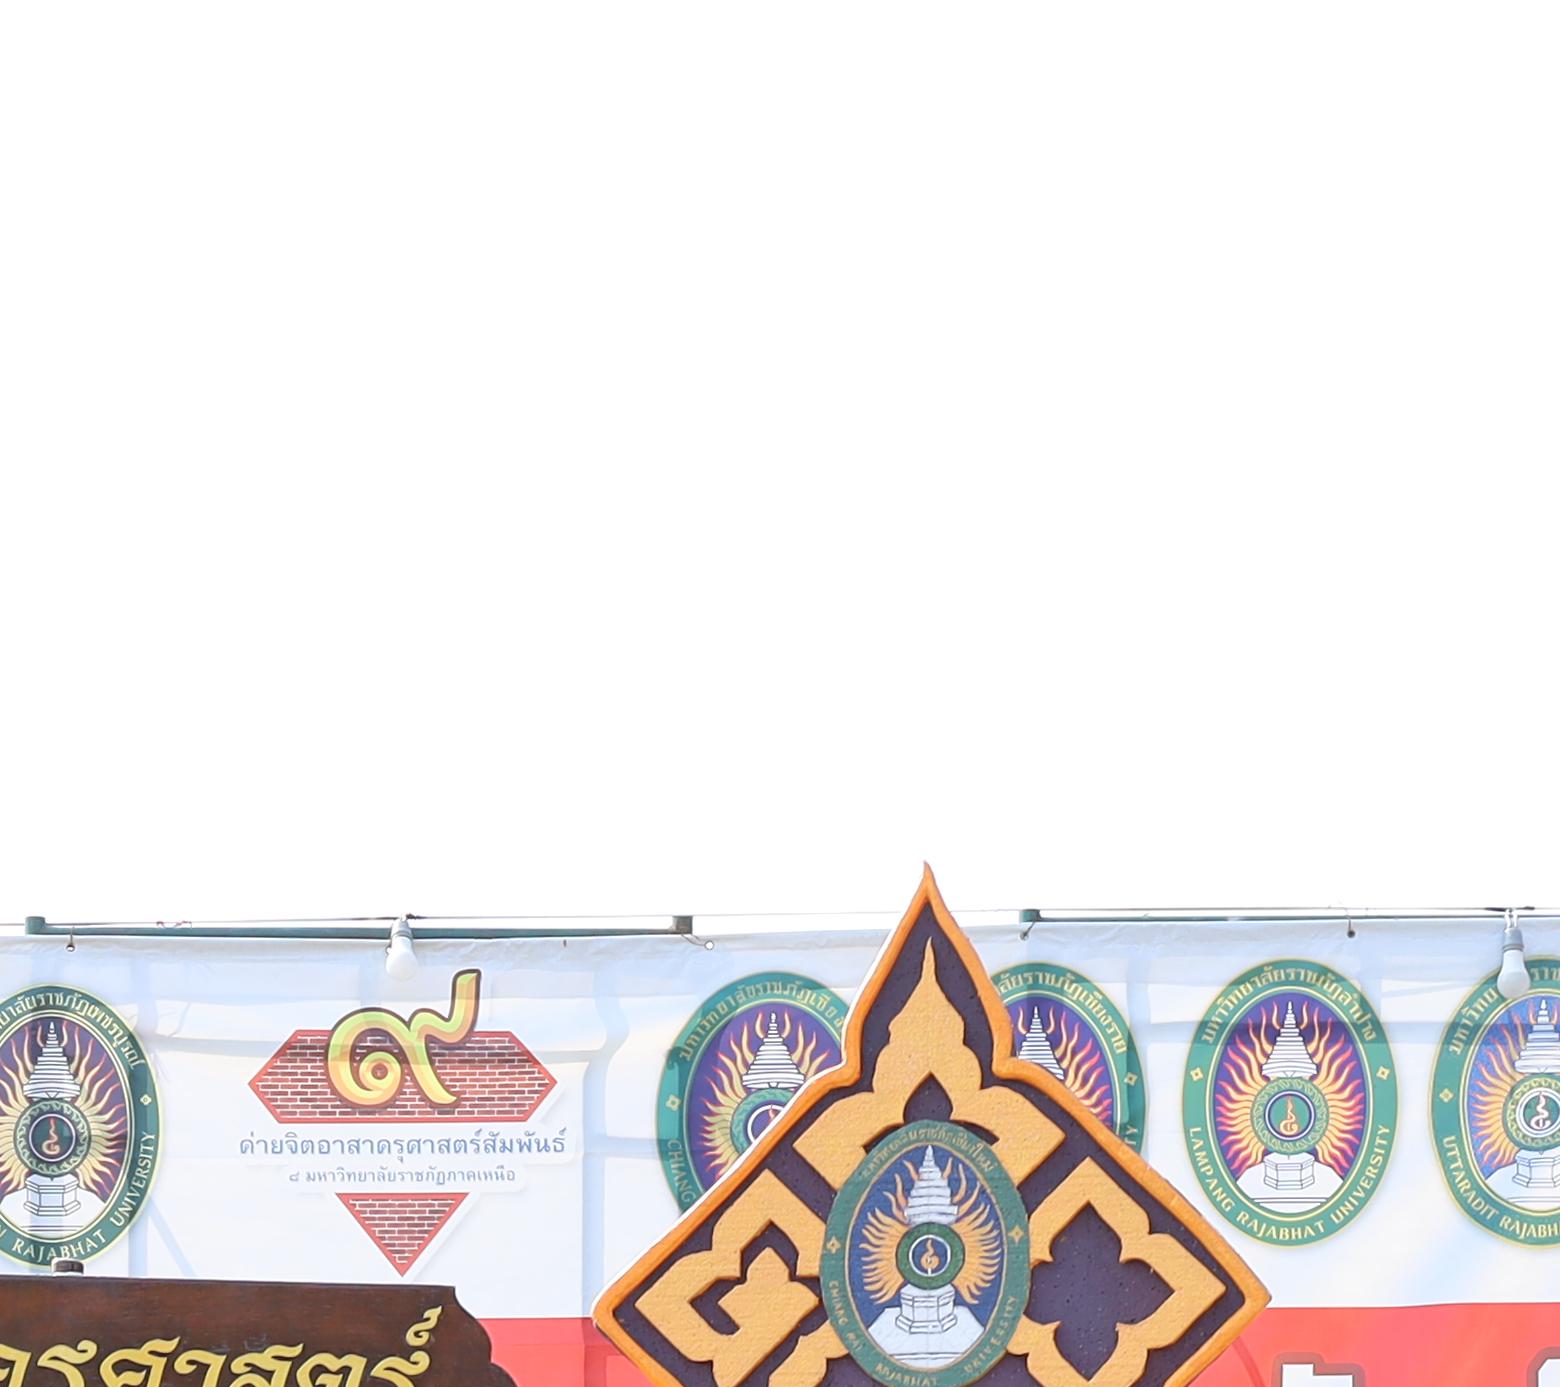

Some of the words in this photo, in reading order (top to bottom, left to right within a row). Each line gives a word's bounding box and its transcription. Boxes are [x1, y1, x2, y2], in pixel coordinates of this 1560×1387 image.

[997, 970, 1129, 1056] ลัยราชภัฏเชียงราย
[239, 1127, 568, 1163] ค่ายจิตอาสาครุศาสตร์สัมพันธ์
[1188, 1126, 1237, 1213] LAMPANG
[1235, 1210, 1327, 1241] RAJABHAT
[1330, 1124, 1392, 1225] UNIVERSITY
[1442, 1135, 1500, 1221] UTTARADIT
[11, 1231, 107, 1263] RAJABHAT
[109, 1130, 156, 1229] UNIVERSITY
